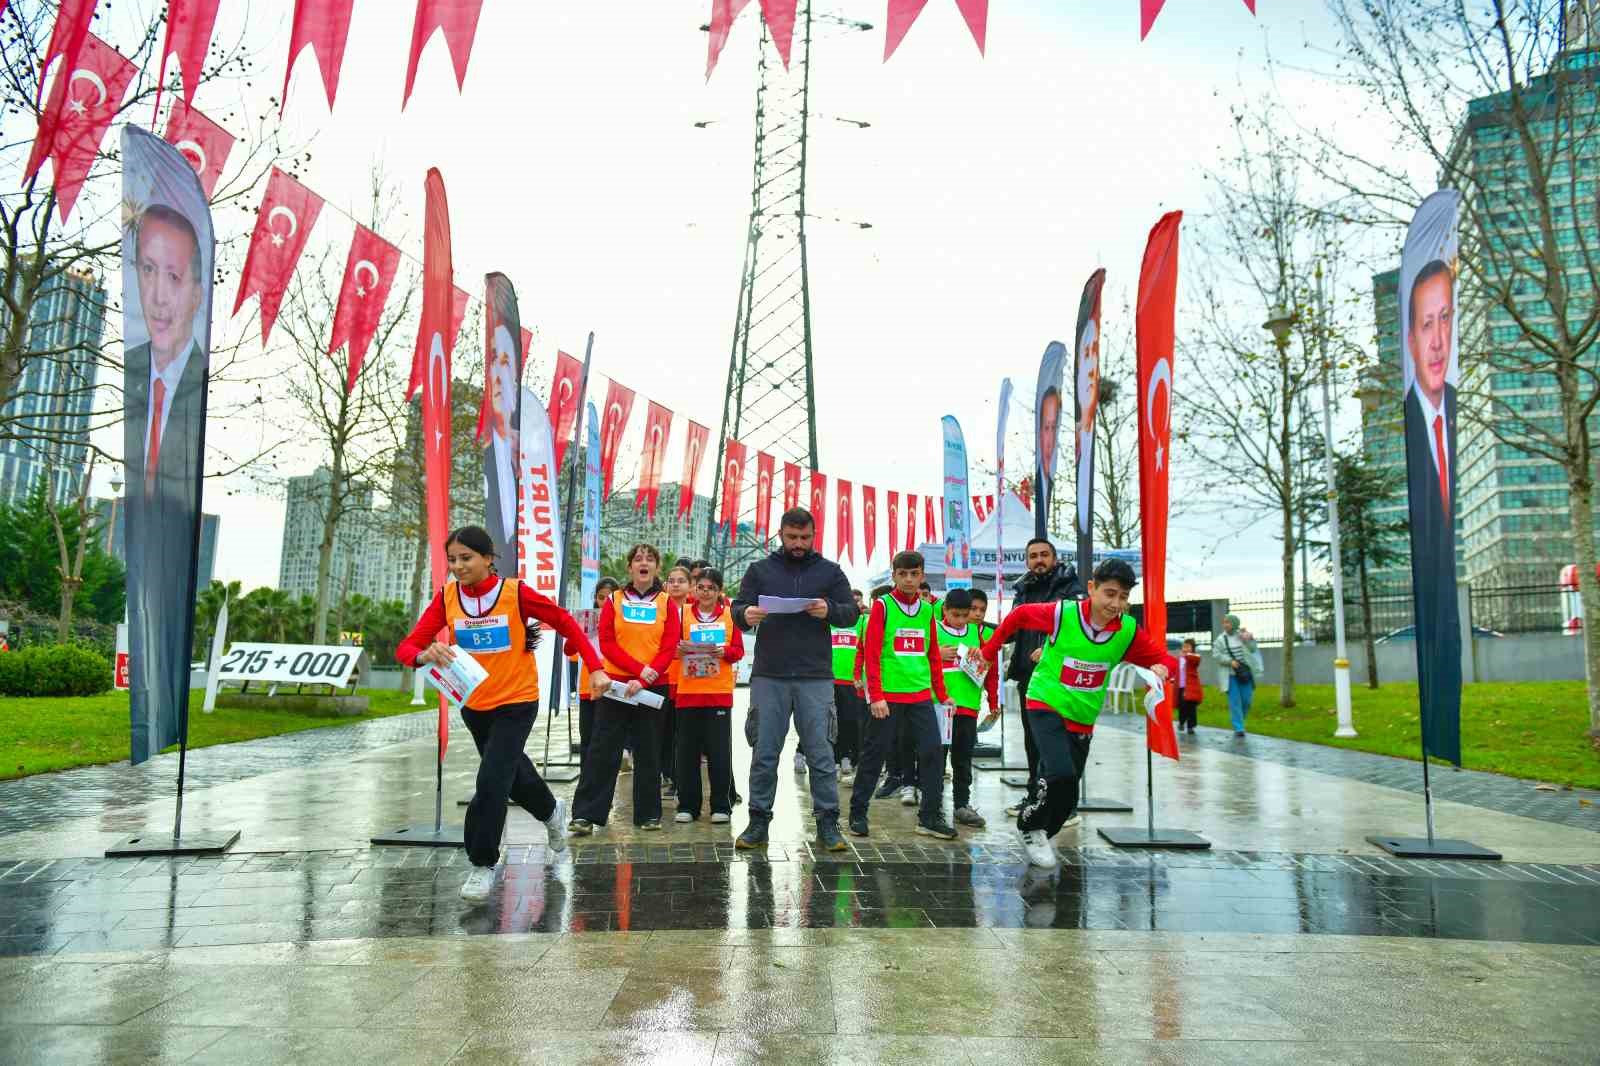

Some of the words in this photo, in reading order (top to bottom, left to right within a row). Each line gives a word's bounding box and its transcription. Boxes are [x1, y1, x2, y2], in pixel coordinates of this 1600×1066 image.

[630, 608, 646, 618] B-4
[472, 630, 492, 646] B-3
[1074, 672, 1094, 685] A-3
